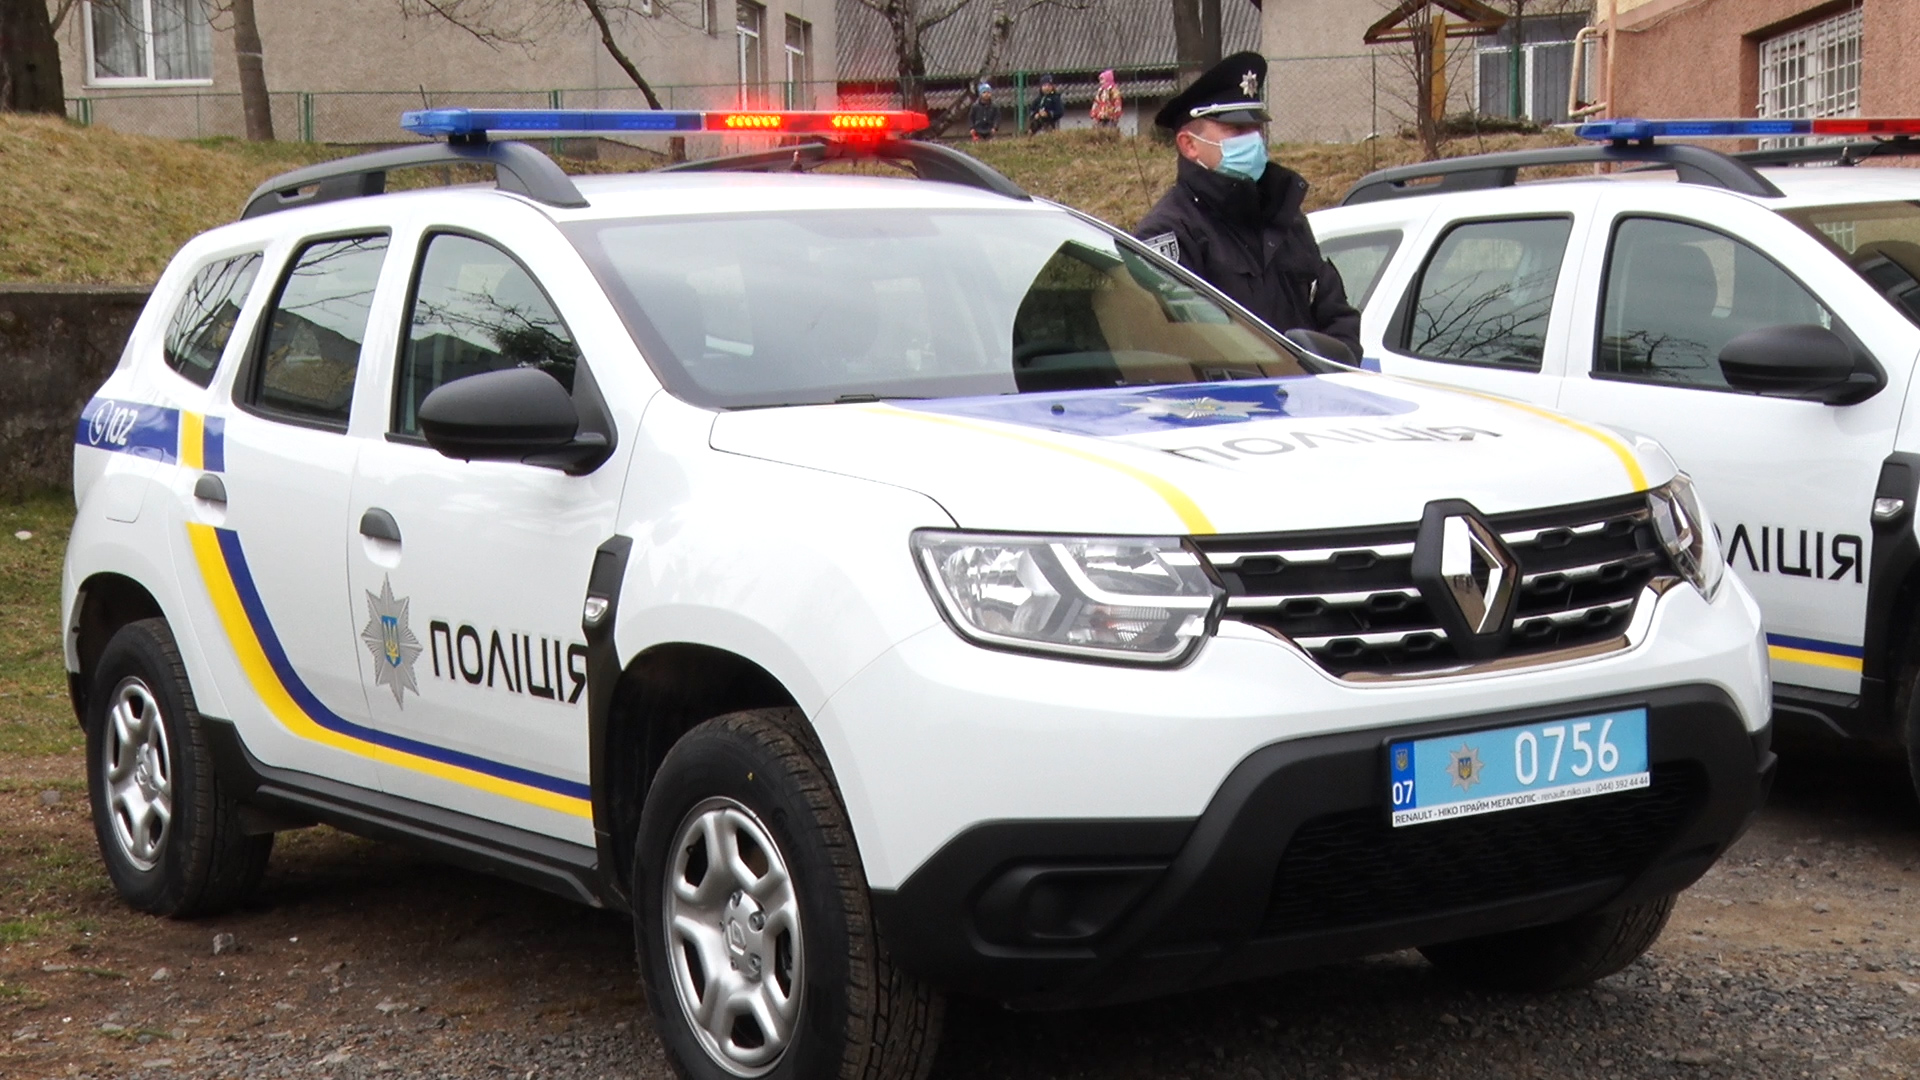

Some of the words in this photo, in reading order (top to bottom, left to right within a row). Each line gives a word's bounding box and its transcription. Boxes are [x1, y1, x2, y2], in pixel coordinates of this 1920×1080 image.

[105, 407, 138, 446] 102
[1160, 425, 1503, 467] ПОЛІЦІЯ
[1712, 522, 1863, 584] ЛІЦІЯ
[429, 619, 588, 704] ПОЛІЦІЯ
[1514, 718, 1619, 786] 0756
[1391, 780, 1414, 806] 07
[1394, 810, 1433, 824] RENAULT
[1438, 806, 1459, 818] НІКО
[1459, 801, 1490, 814] ПРАЙМ
[1491, 794, 1537, 810] МЕГАПОЛІС
[1595, 782, 1614, 795] (044)
[1615, 779, 1628, 789] 392
